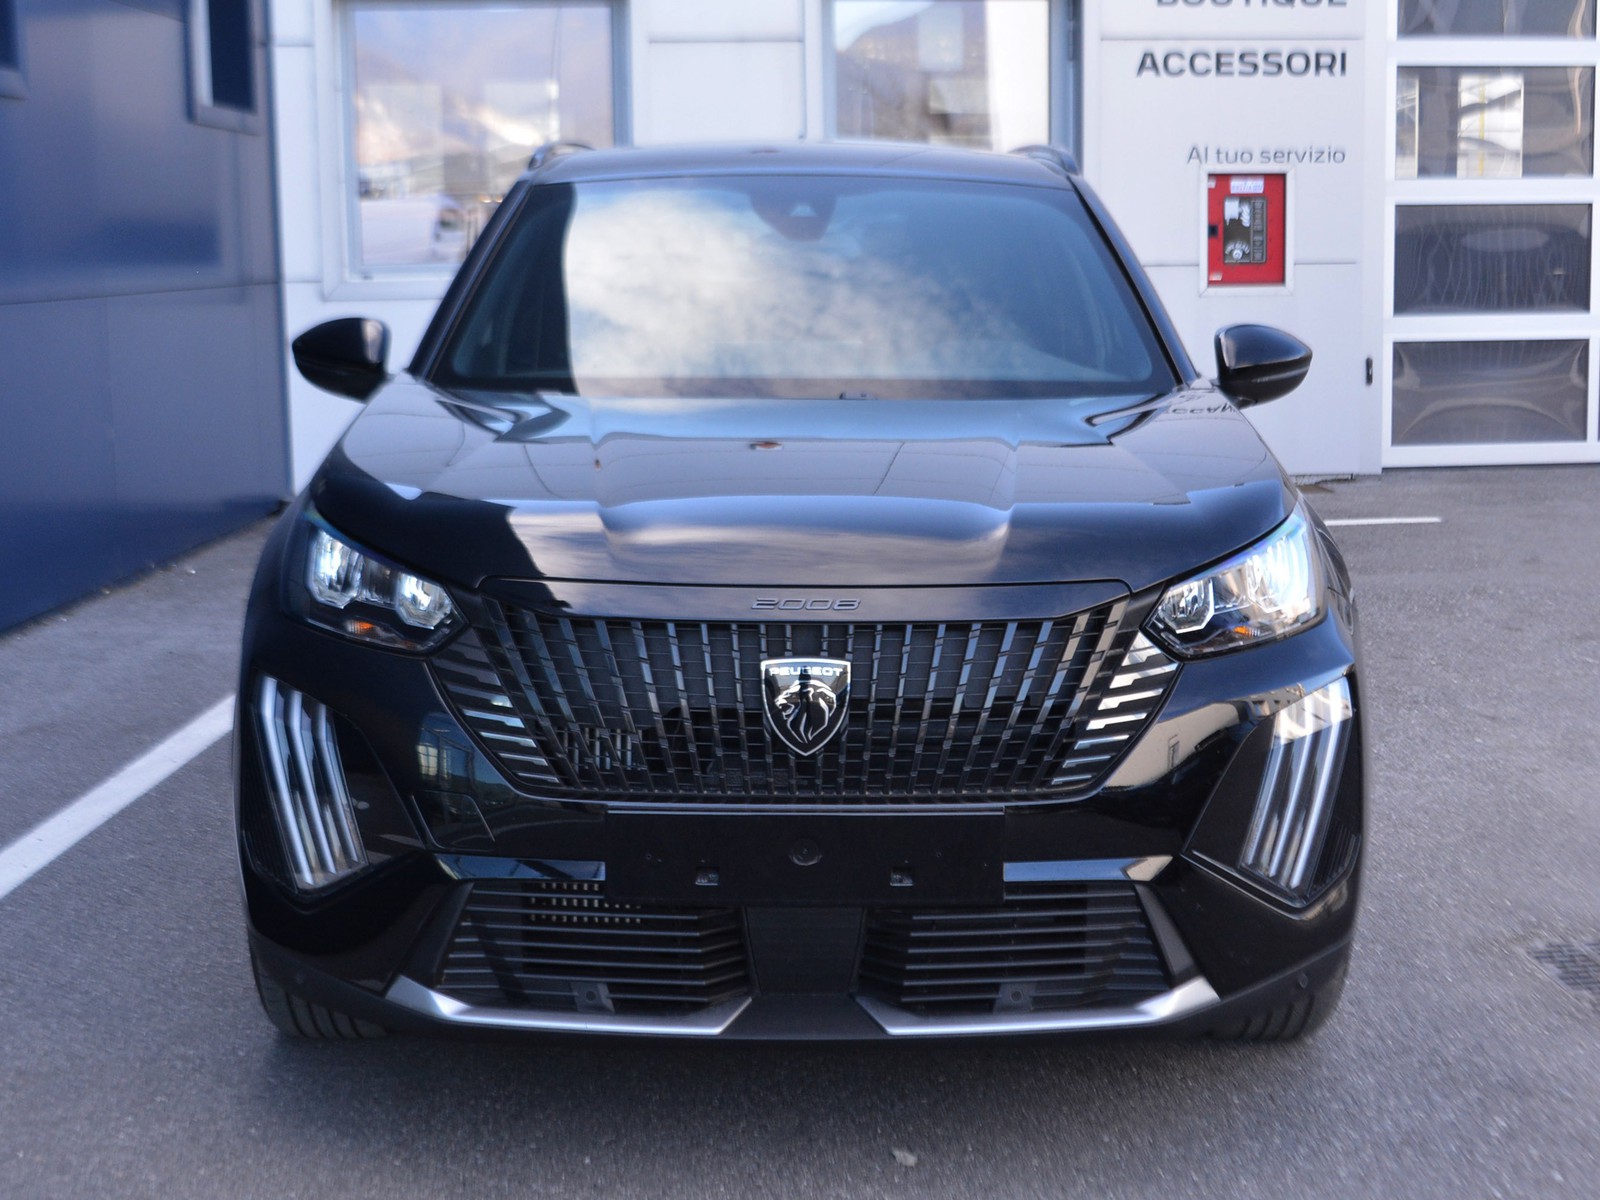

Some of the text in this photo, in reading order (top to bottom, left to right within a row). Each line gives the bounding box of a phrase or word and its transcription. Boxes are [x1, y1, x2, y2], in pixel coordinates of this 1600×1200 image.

[1137, 51, 1347, 77] ACCESSORI
[1187, 146, 1346, 164] Al tuo servizio
[751, 598, 861, 610] 2008
[769, 666, 843, 676] PEUGEOT
